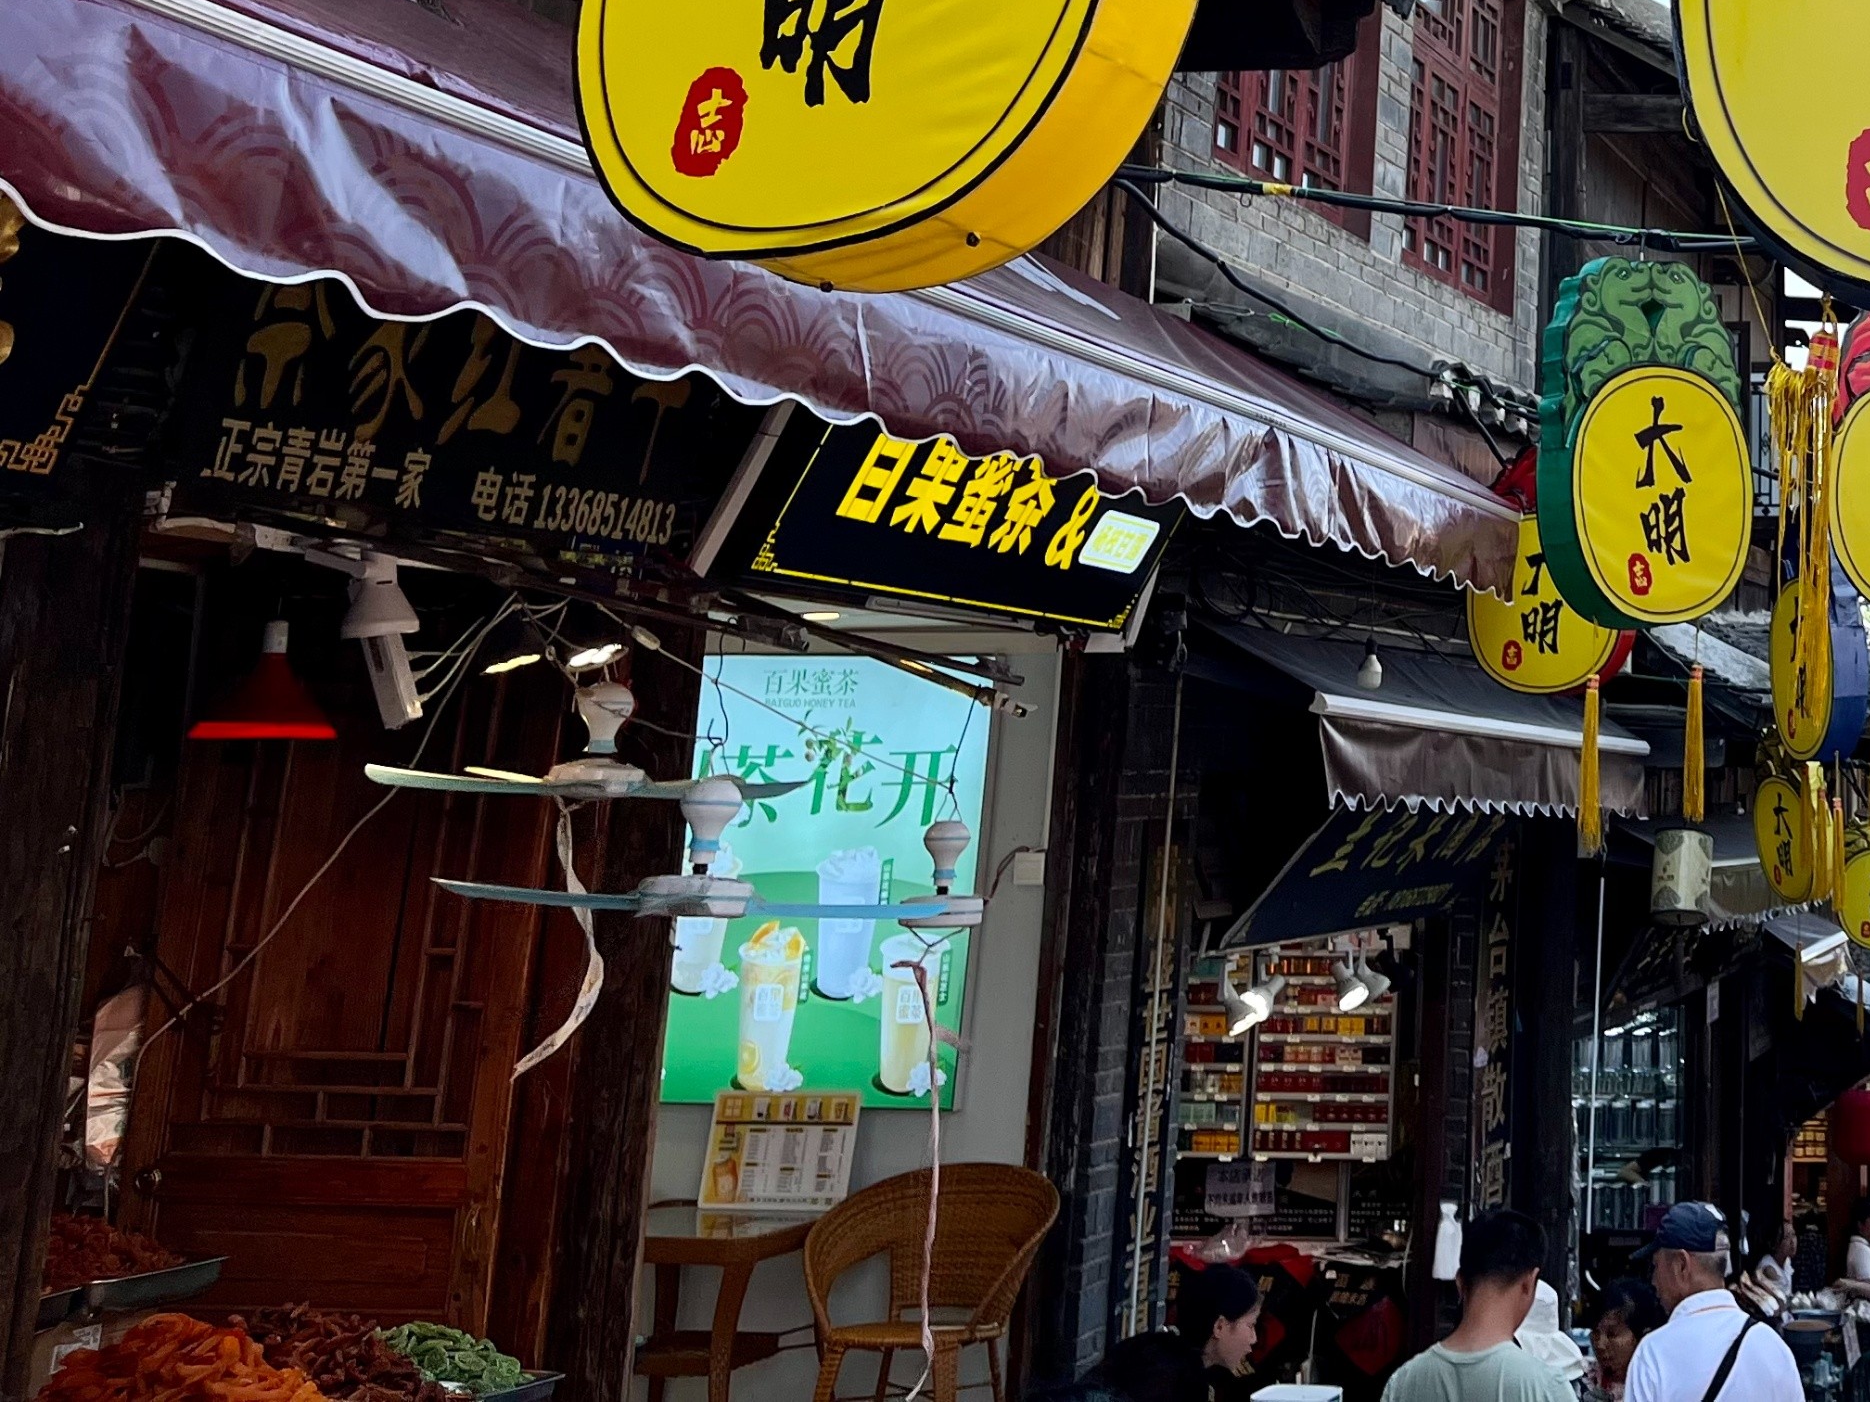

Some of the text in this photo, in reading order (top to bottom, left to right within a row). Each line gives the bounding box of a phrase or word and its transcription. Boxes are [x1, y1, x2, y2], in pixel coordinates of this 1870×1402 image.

[200, 417, 432, 509] 正宗青岩第一家
[1633, 395, 1693, 566] 大明
[470, 467, 677, 547] 电话 13368514813
[763, 667, 859, 696] 百果蜜茶
[803, 697, 835, 709] HONEY
[838, 697, 857, 709] TEA
[1772, 792, 1794, 878] 大明
